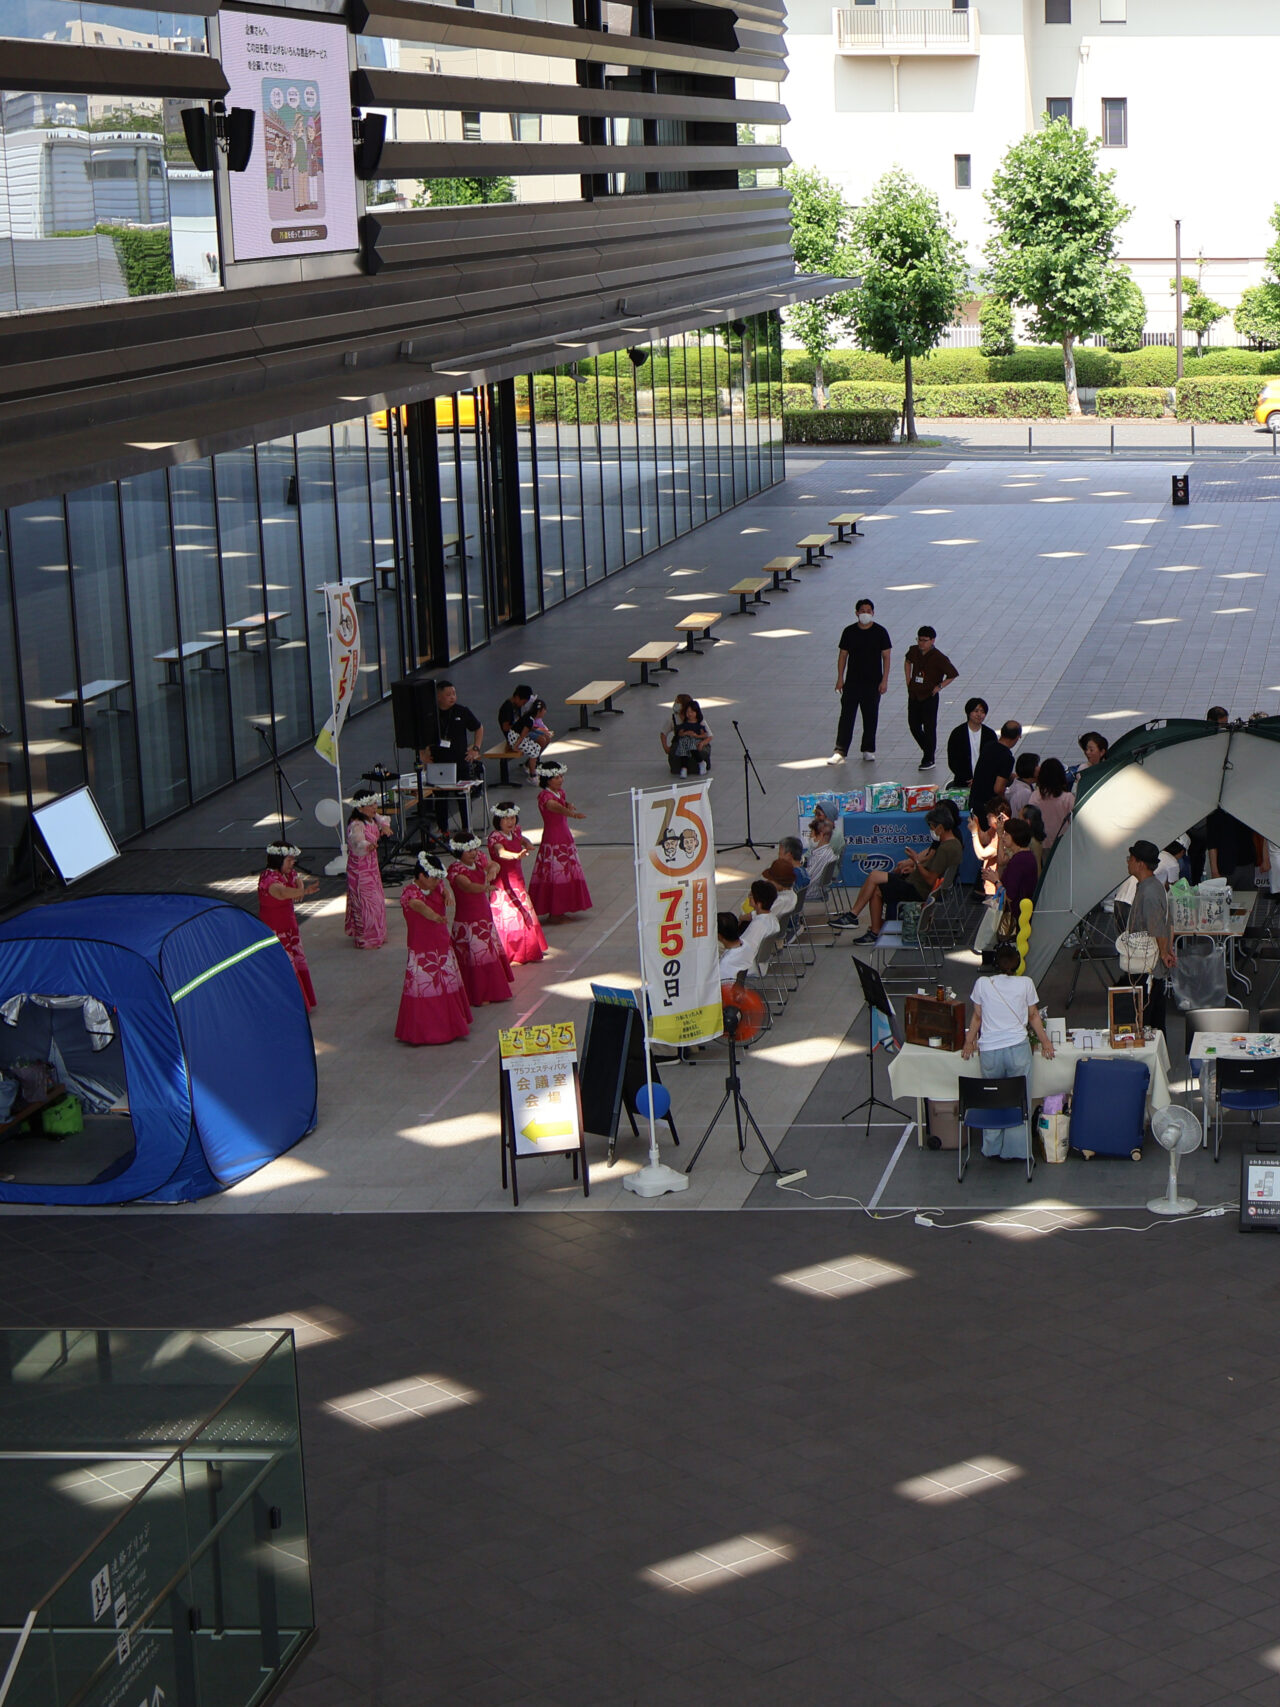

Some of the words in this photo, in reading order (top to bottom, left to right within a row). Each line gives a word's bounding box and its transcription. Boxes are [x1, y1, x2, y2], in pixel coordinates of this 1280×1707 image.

[873, 823, 908, 834] 自分らしく
[862, 860, 890, 870] リリーフ
[696, 881, 705, 933] 7月5日は
[514, 1063, 568, 1075] 75フェスティバル
[517, 1073, 567, 1091] 会議室
